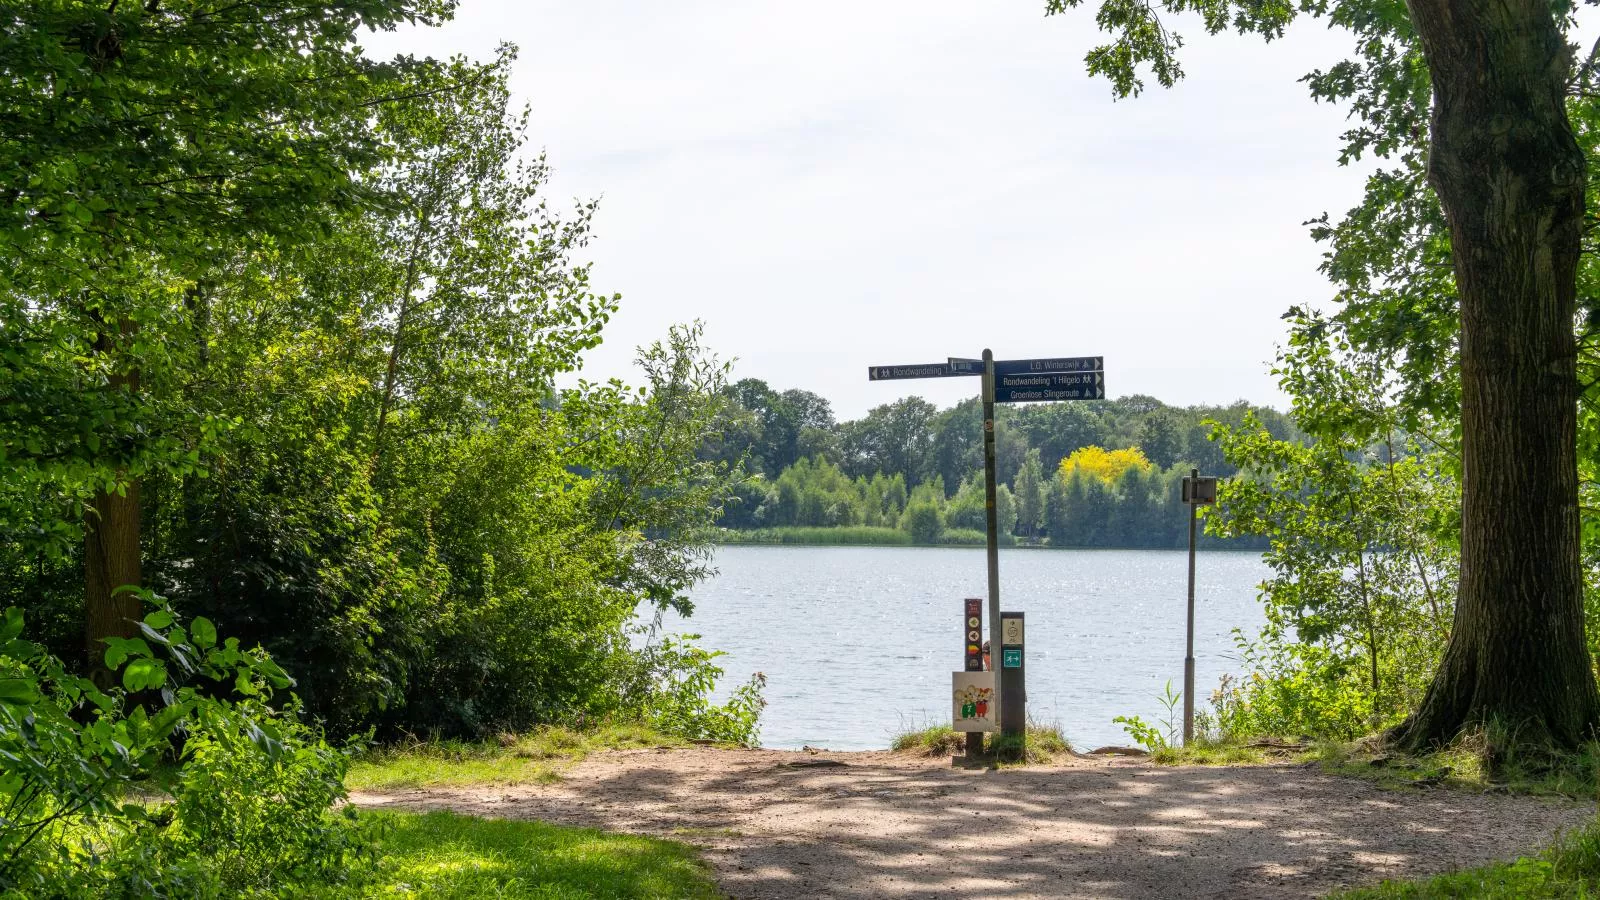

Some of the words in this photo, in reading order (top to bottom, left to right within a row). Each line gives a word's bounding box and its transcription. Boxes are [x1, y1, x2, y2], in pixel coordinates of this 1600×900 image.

[1044, 360, 1080, 370] Winterswijk
[893, 366, 942, 376] Rondwandeling
[1004, 376, 1050, 386] Rondwandeling
[1058, 376, 1080, 386] Hilgelo
[1010, 390, 1042, 399] Groenlose
[1044, 389, 1080, 399] Slingeroute
